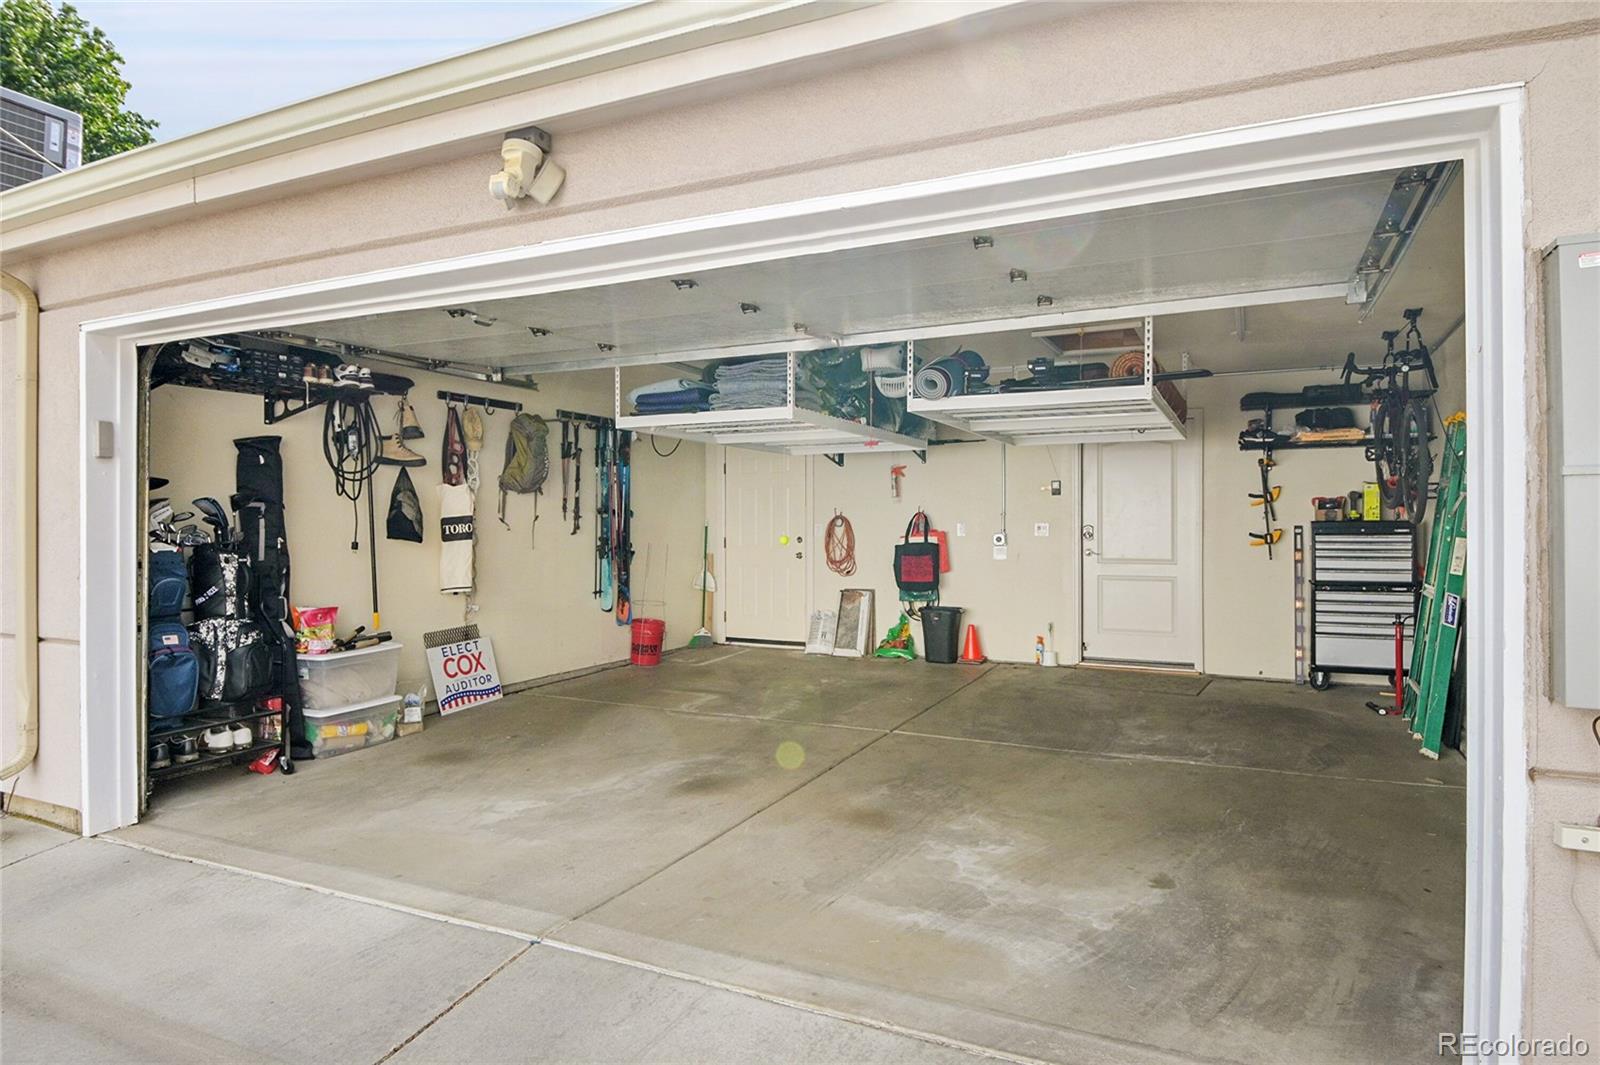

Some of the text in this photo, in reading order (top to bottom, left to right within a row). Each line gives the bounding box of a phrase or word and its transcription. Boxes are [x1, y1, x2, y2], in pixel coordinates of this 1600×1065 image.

[443, 523, 473, 535] TORO
[441, 640, 479, 658] ELECT
[443, 651, 486, 679] COX
[445, 674, 492, 695] AUDITOR
